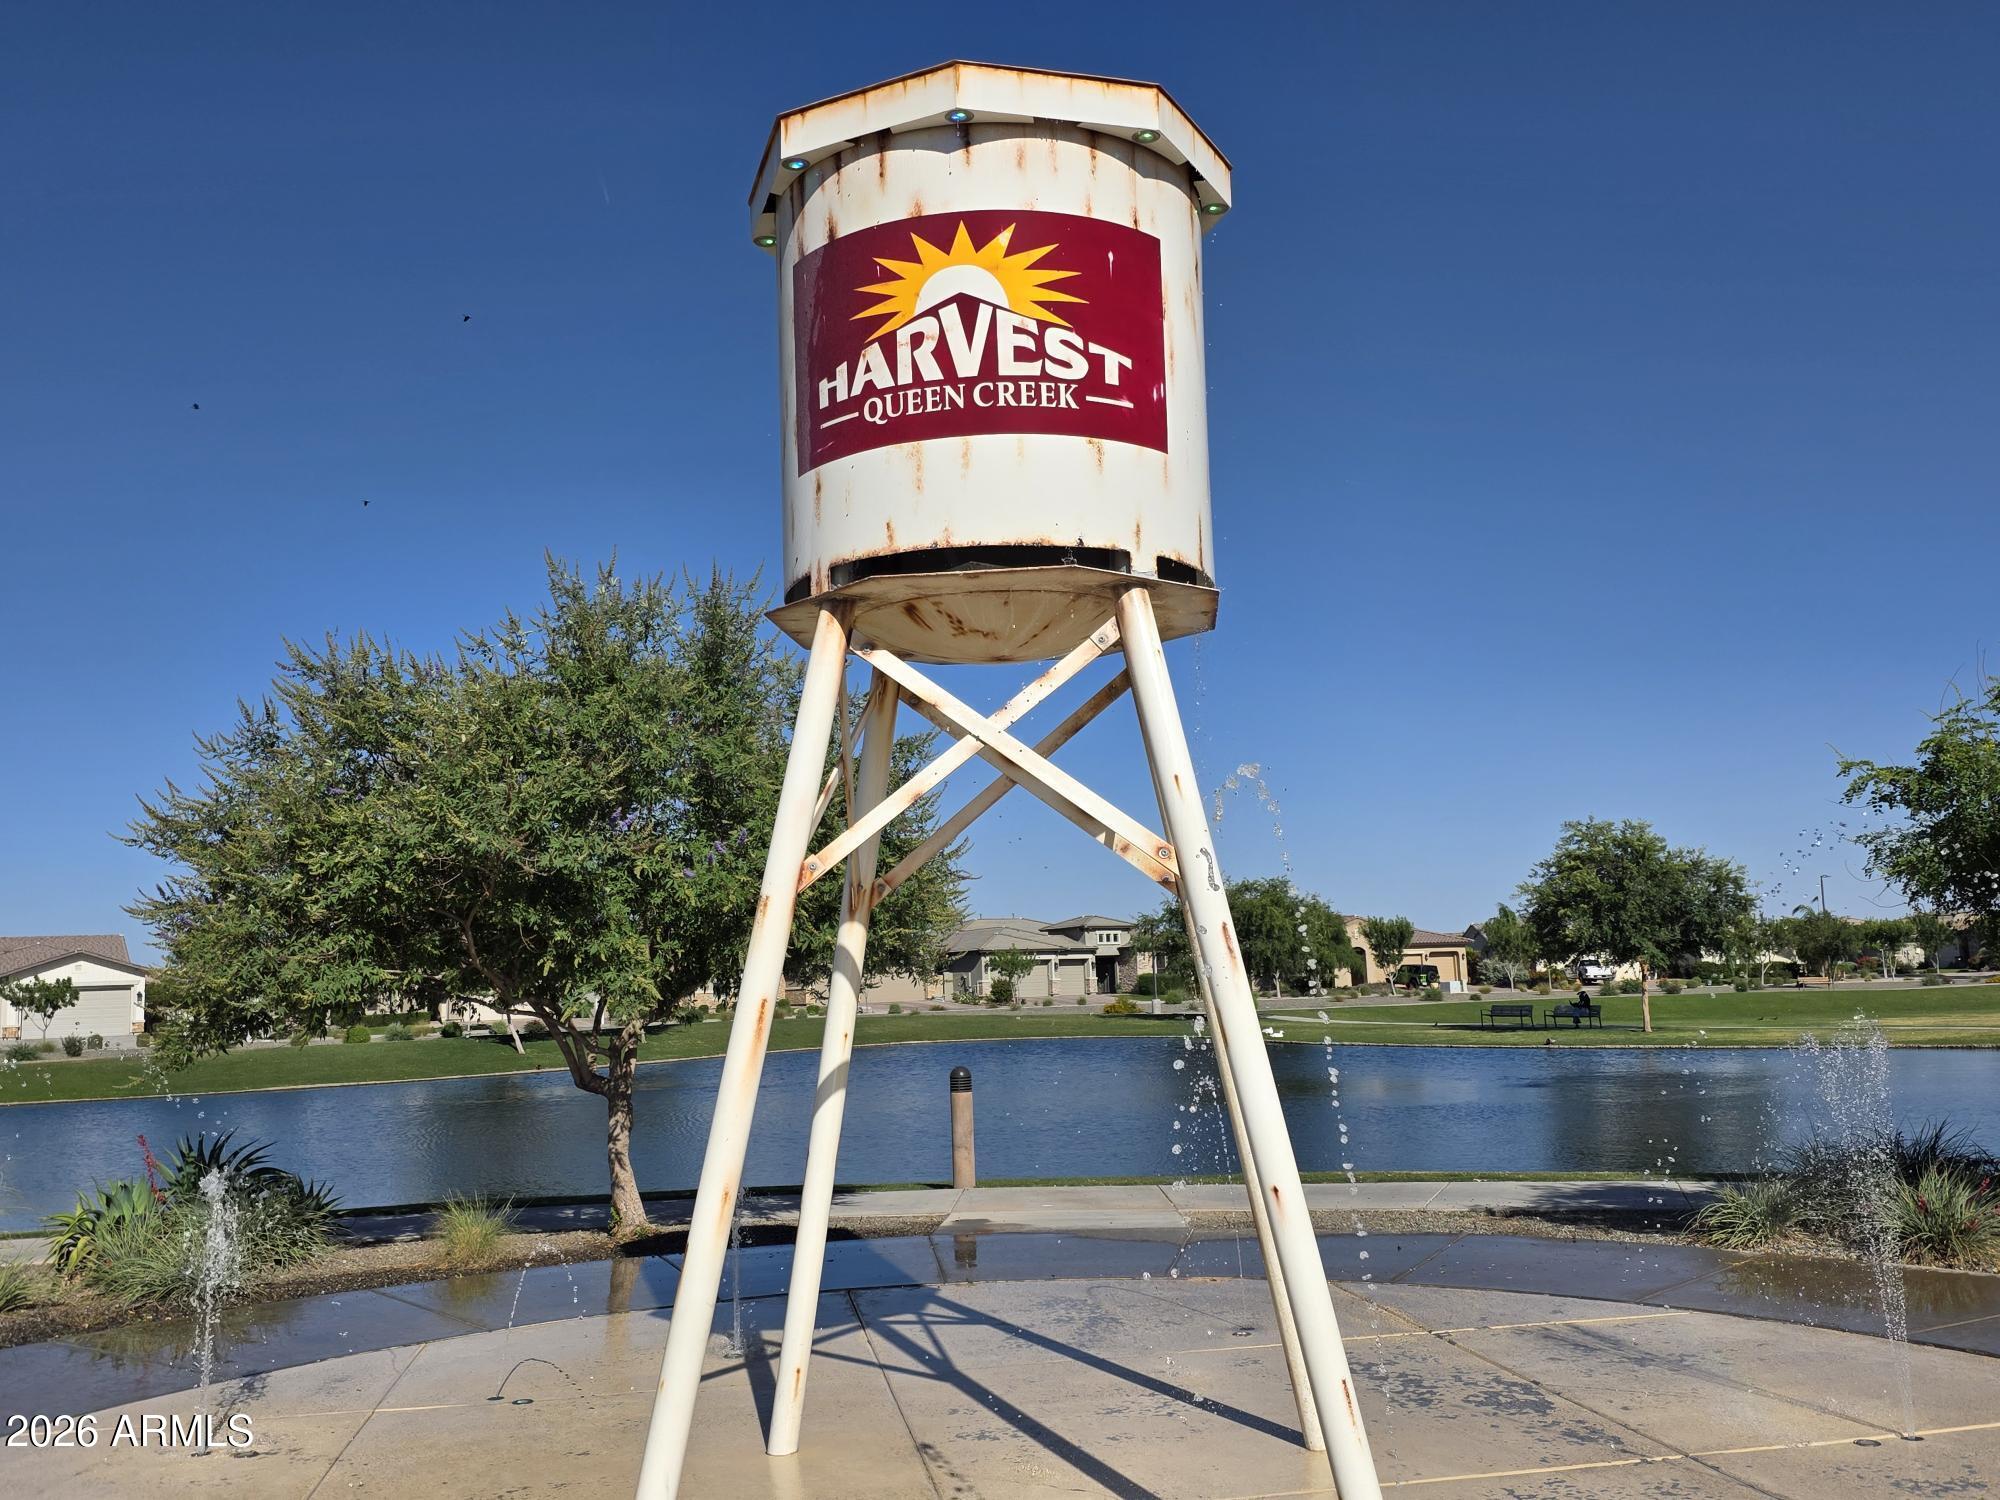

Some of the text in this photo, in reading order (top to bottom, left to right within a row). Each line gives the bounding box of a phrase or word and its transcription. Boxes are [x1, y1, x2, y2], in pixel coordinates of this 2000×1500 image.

[818, 302, 1133, 409] HARVEST
[863, 381, 1080, 425] QUEEN CREEK
